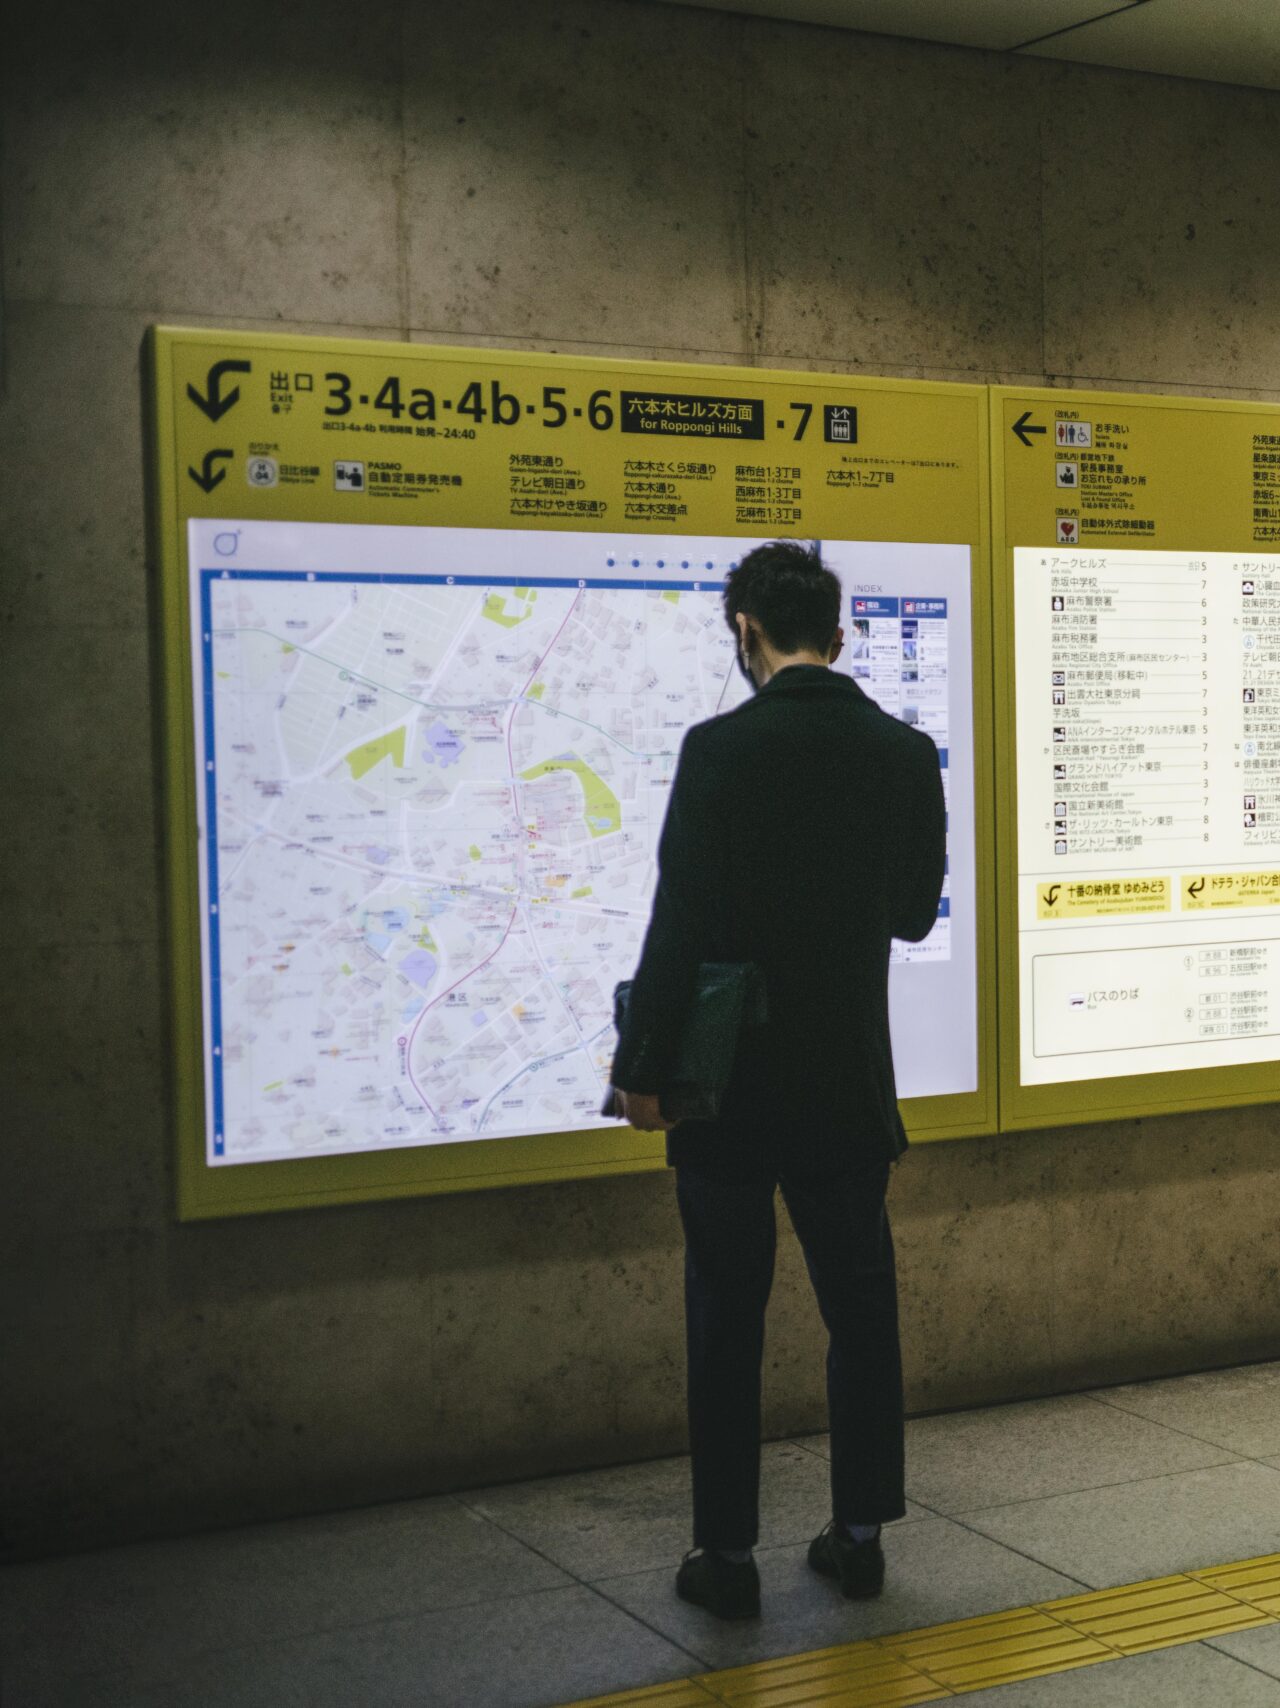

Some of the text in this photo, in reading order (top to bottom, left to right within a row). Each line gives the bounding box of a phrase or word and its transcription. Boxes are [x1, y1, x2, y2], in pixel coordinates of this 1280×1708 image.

[270, 371, 314, 392] 出口
[270, 390, 292, 403] Exit
[628, 398, 752, 423] 六本木ヒルズ方面
[640, 416, 743, 436] for Roppongi Hills
[1095, 423, 1130, 435] お手洗い
[368, 461, 403, 471] PASMO
[510, 454, 563, 468] 外苑東通り
[624, 459, 716, 474] 六本木さくら坂通り
[1081, 462, 1123, 474] 駅長事務室
[368, 471, 463, 487] 自動定期券発売機
[511, 476, 585, 490] テレビ朝日通り
[1081, 474, 1147, 486] お忘れもの承り所
[624, 481, 676, 494] 六本木通り
[511, 498, 608, 512] 六本木けやき坂通り
[624, 502, 688, 516] 六本木交差点
[1051, 557, 1108, 569] アークヒルズ
[1201, 561, 1208, 572] 5
[854, 585, 883, 593] INDEX
[1051, 577, 1208, 590] 赤坂中学校 7
[1066, 595, 1208, 608] 麻布警察署 6
[1052, 614, 1208, 626] 麻布消防署 3
[1201, 634, 1208, 644] 3
[1202, 652, 1208, 662] 3
[1202, 671, 1208, 681] 5
[1202, 689, 1209, 699] 7
[1202, 707, 1209, 717] 3
[1202, 724, 1209, 735] 5
[1203, 742, 1209, 752] 7
[1069, 760, 1209, 774] グランドハイアット東京 3
[1054, 779, 1209, 793] 国際文化会館 3
[1203, 797, 1210, 807] 7
[1203, 815, 1210, 825] 8
[1070, 832, 1210, 849] サントリー美術館 8
[1088, 987, 1140, 1002] バスのりば
